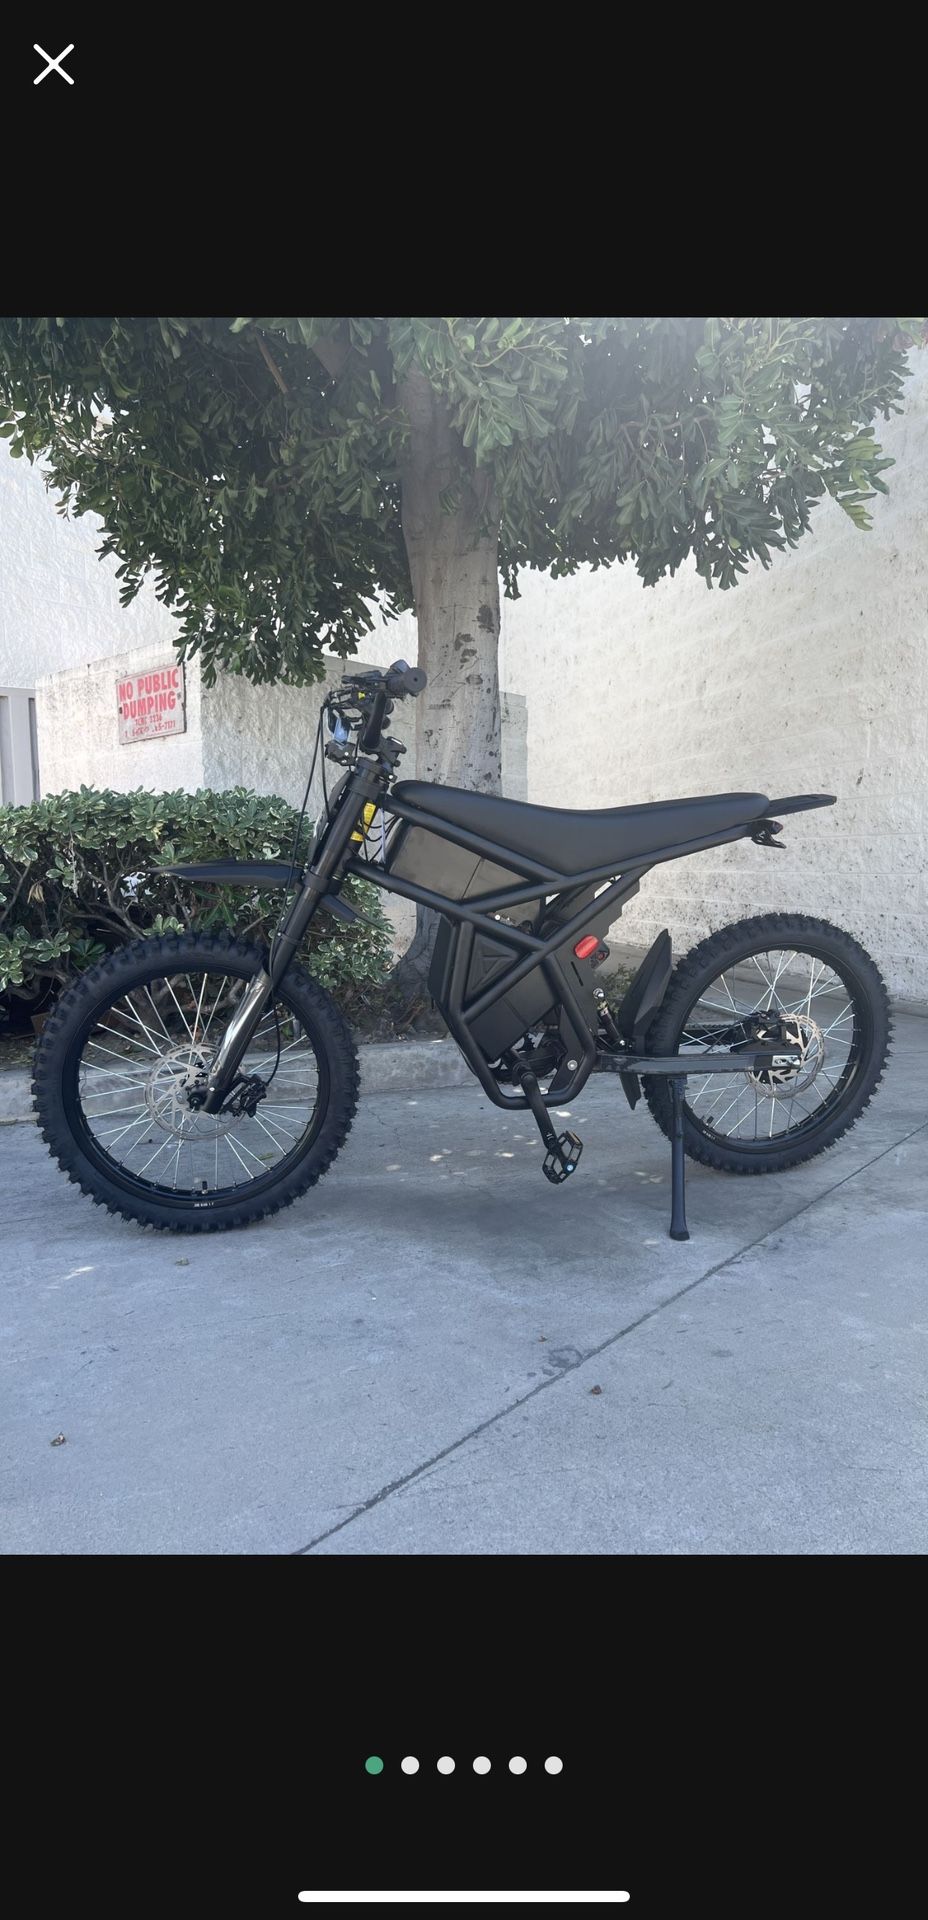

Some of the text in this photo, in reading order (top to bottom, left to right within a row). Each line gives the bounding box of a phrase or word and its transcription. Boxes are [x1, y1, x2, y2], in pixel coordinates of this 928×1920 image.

[119, 668, 179, 702] NO PUBLIC
[123, 690, 176, 720] DUMPING
